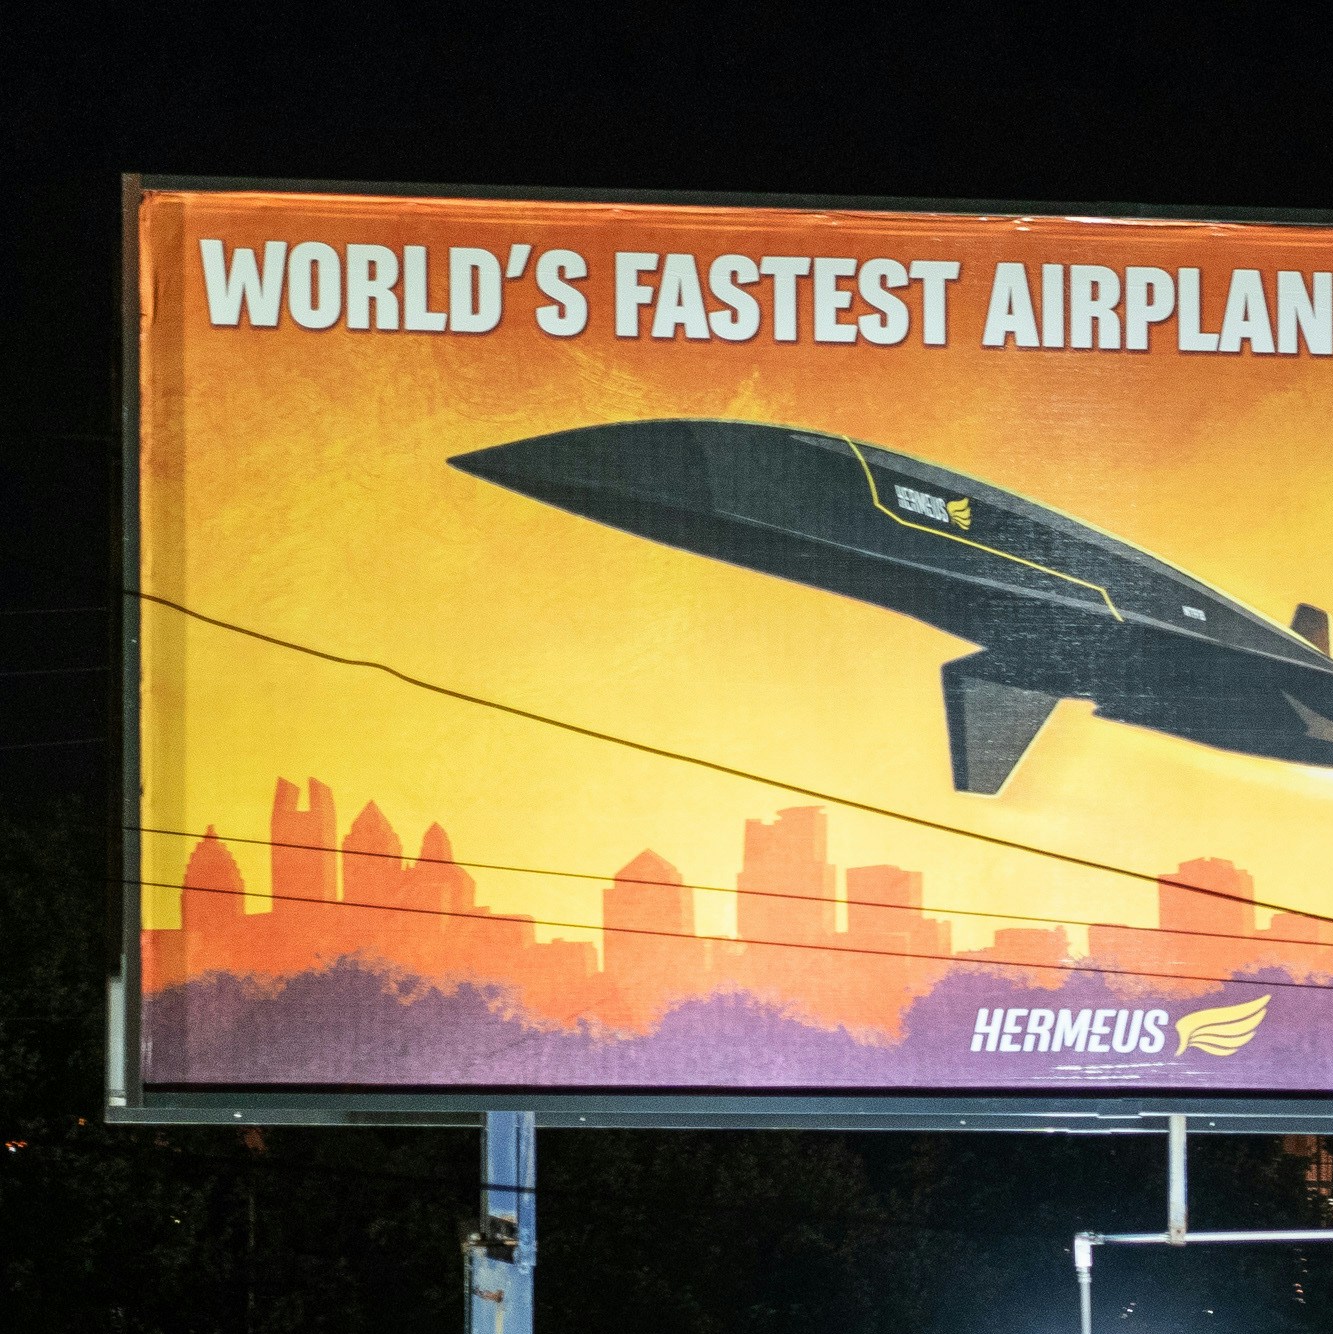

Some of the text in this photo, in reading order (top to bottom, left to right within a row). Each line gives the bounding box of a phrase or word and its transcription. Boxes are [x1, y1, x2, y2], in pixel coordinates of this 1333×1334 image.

[199, 239, 589, 338] WORLD'S
[615, 251, 961, 347] FASTEST
[969, 1007, 1169, 1054] HERMEUS
